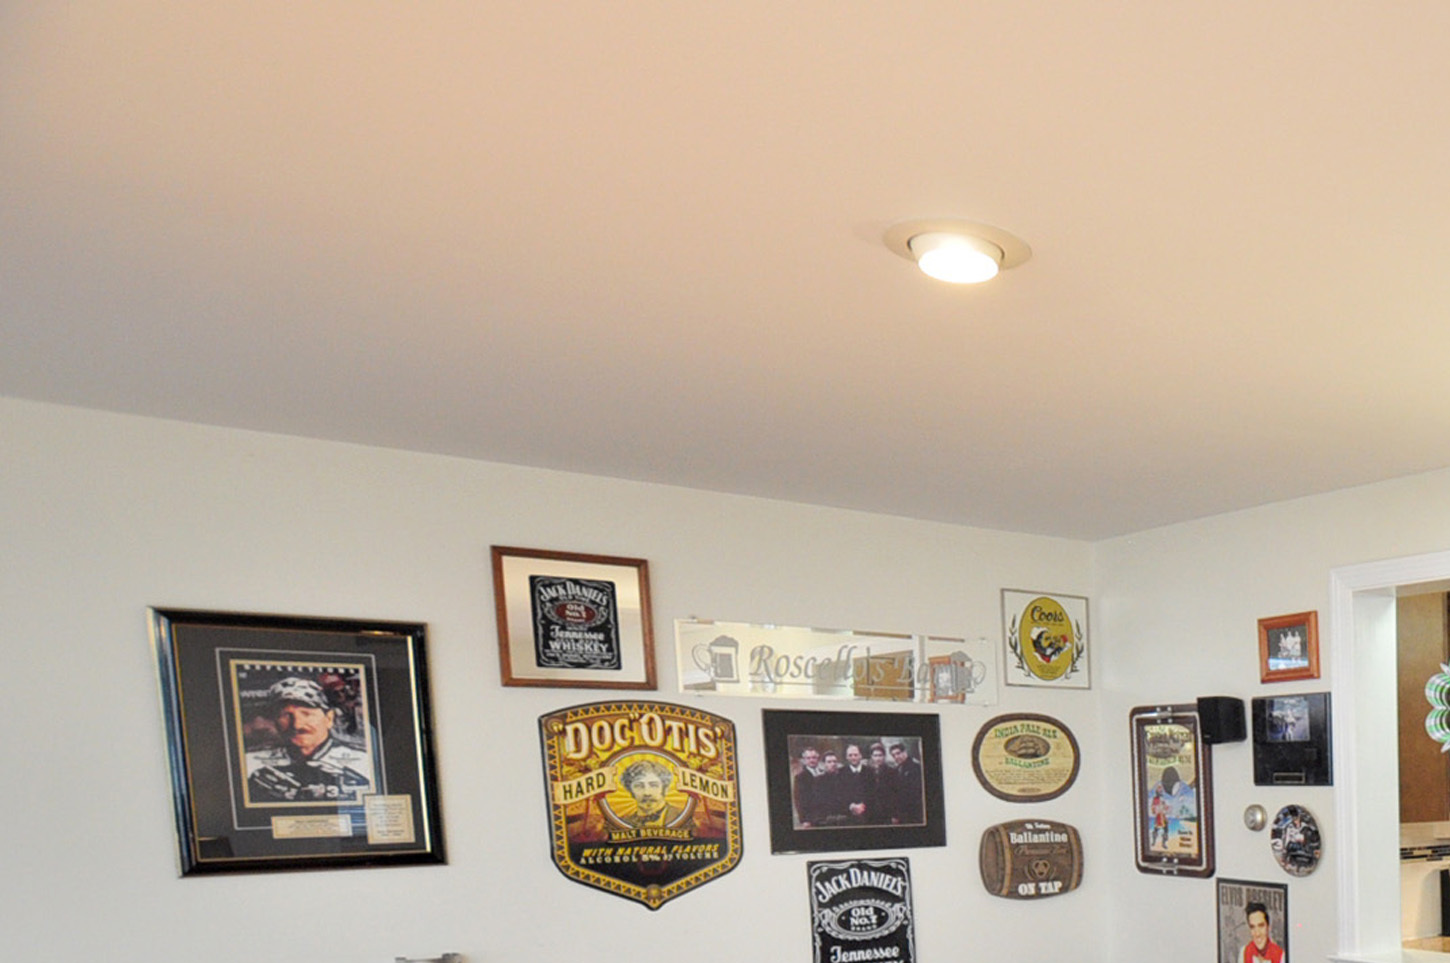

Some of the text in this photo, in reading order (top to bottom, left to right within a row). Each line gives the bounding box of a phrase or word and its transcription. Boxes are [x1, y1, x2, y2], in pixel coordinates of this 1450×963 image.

[539, 584, 567, 602] JACK
[548, 639, 609, 653] WHISKEY
[562, 771, 607, 801] HARD
[682, 770, 730, 799] LEMON
[610, 827, 691, 841] MALT BEVERAGE
[1009, 826, 1069, 845] Ballantine
[582, 843, 720, 858] WITH NATURAL FLAVORS
[815, 867, 906, 903] JACK DANIEL'S
[1017, 880, 1063, 897] ON TAP
[1221, 884, 1245, 908] ELVIS
[851, 906, 874, 917] Old
[830, 945, 900, 963] Tennessee
